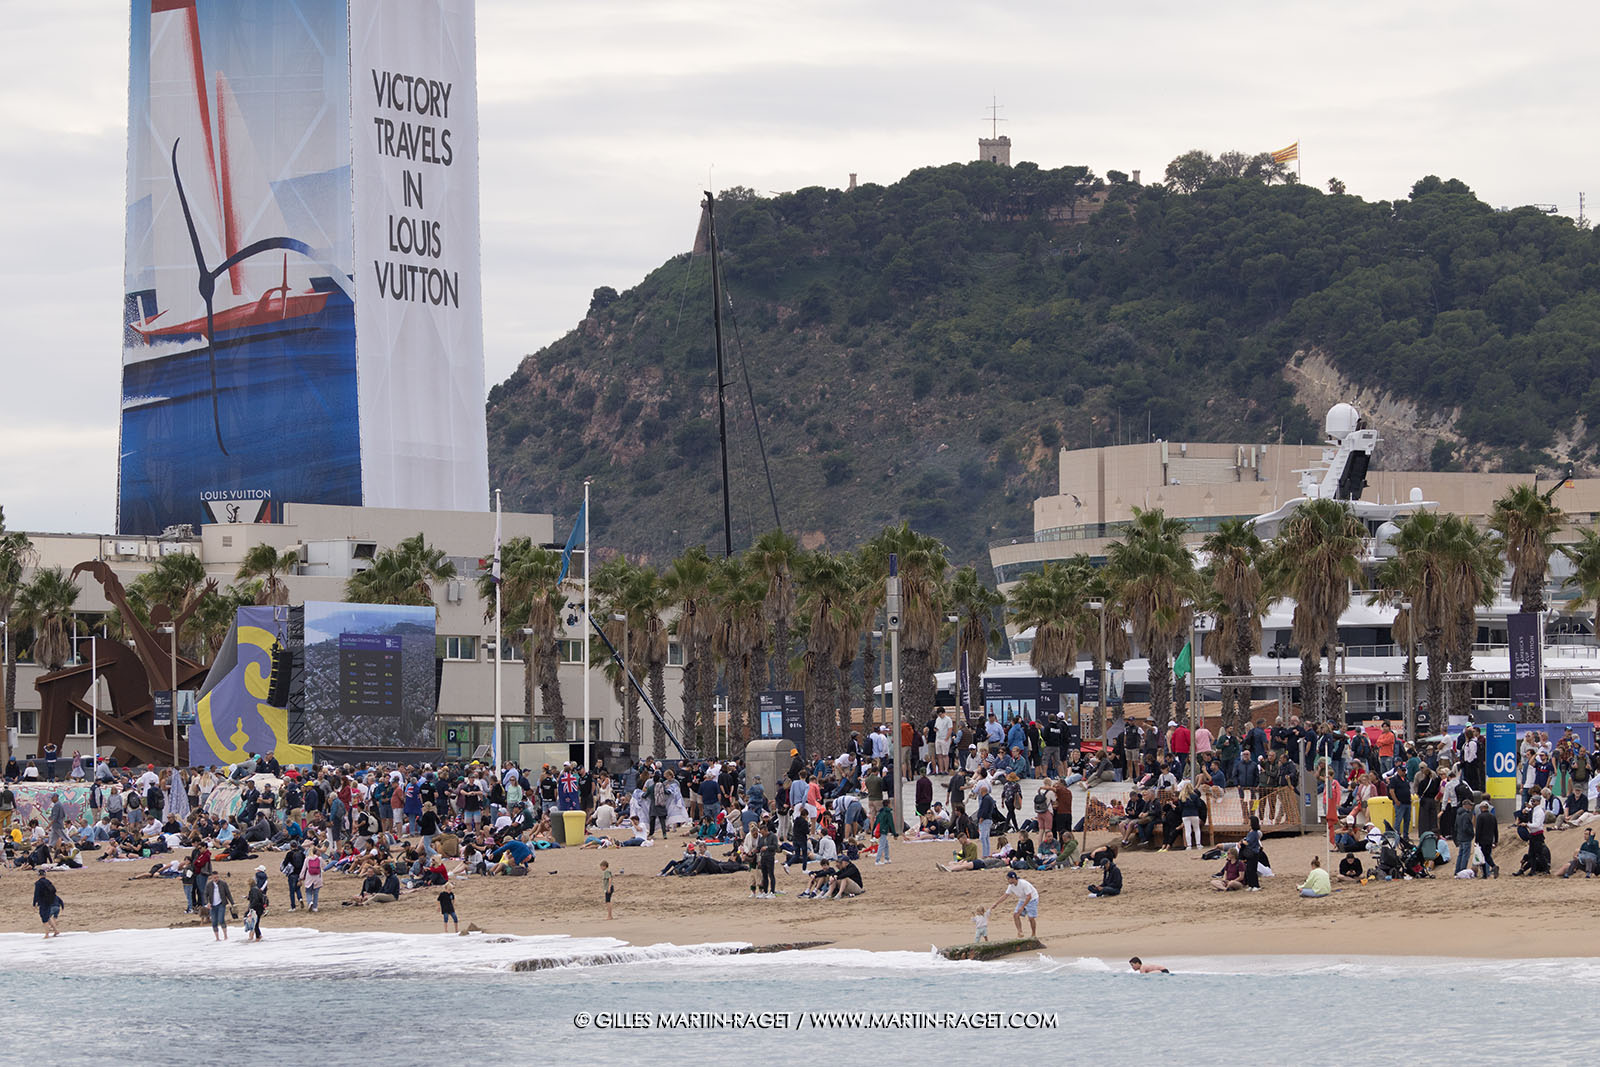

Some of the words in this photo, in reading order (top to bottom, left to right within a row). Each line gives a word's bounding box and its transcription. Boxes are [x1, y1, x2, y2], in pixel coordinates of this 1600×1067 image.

[371, 68, 452, 119] VICTORY
[374, 117, 453, 167] TRAVELS
[402, 169, 424, 210] IN
[388, 214, 442, 259] LOUIS
[374, 260, 459, 309] VUITTON
[200, 491, 228, 500] LOUIS
[230, 489, 271, 499] VUITTON
[449, 730, 456, 740] P
[1493, 752, 1516, 773] 06
